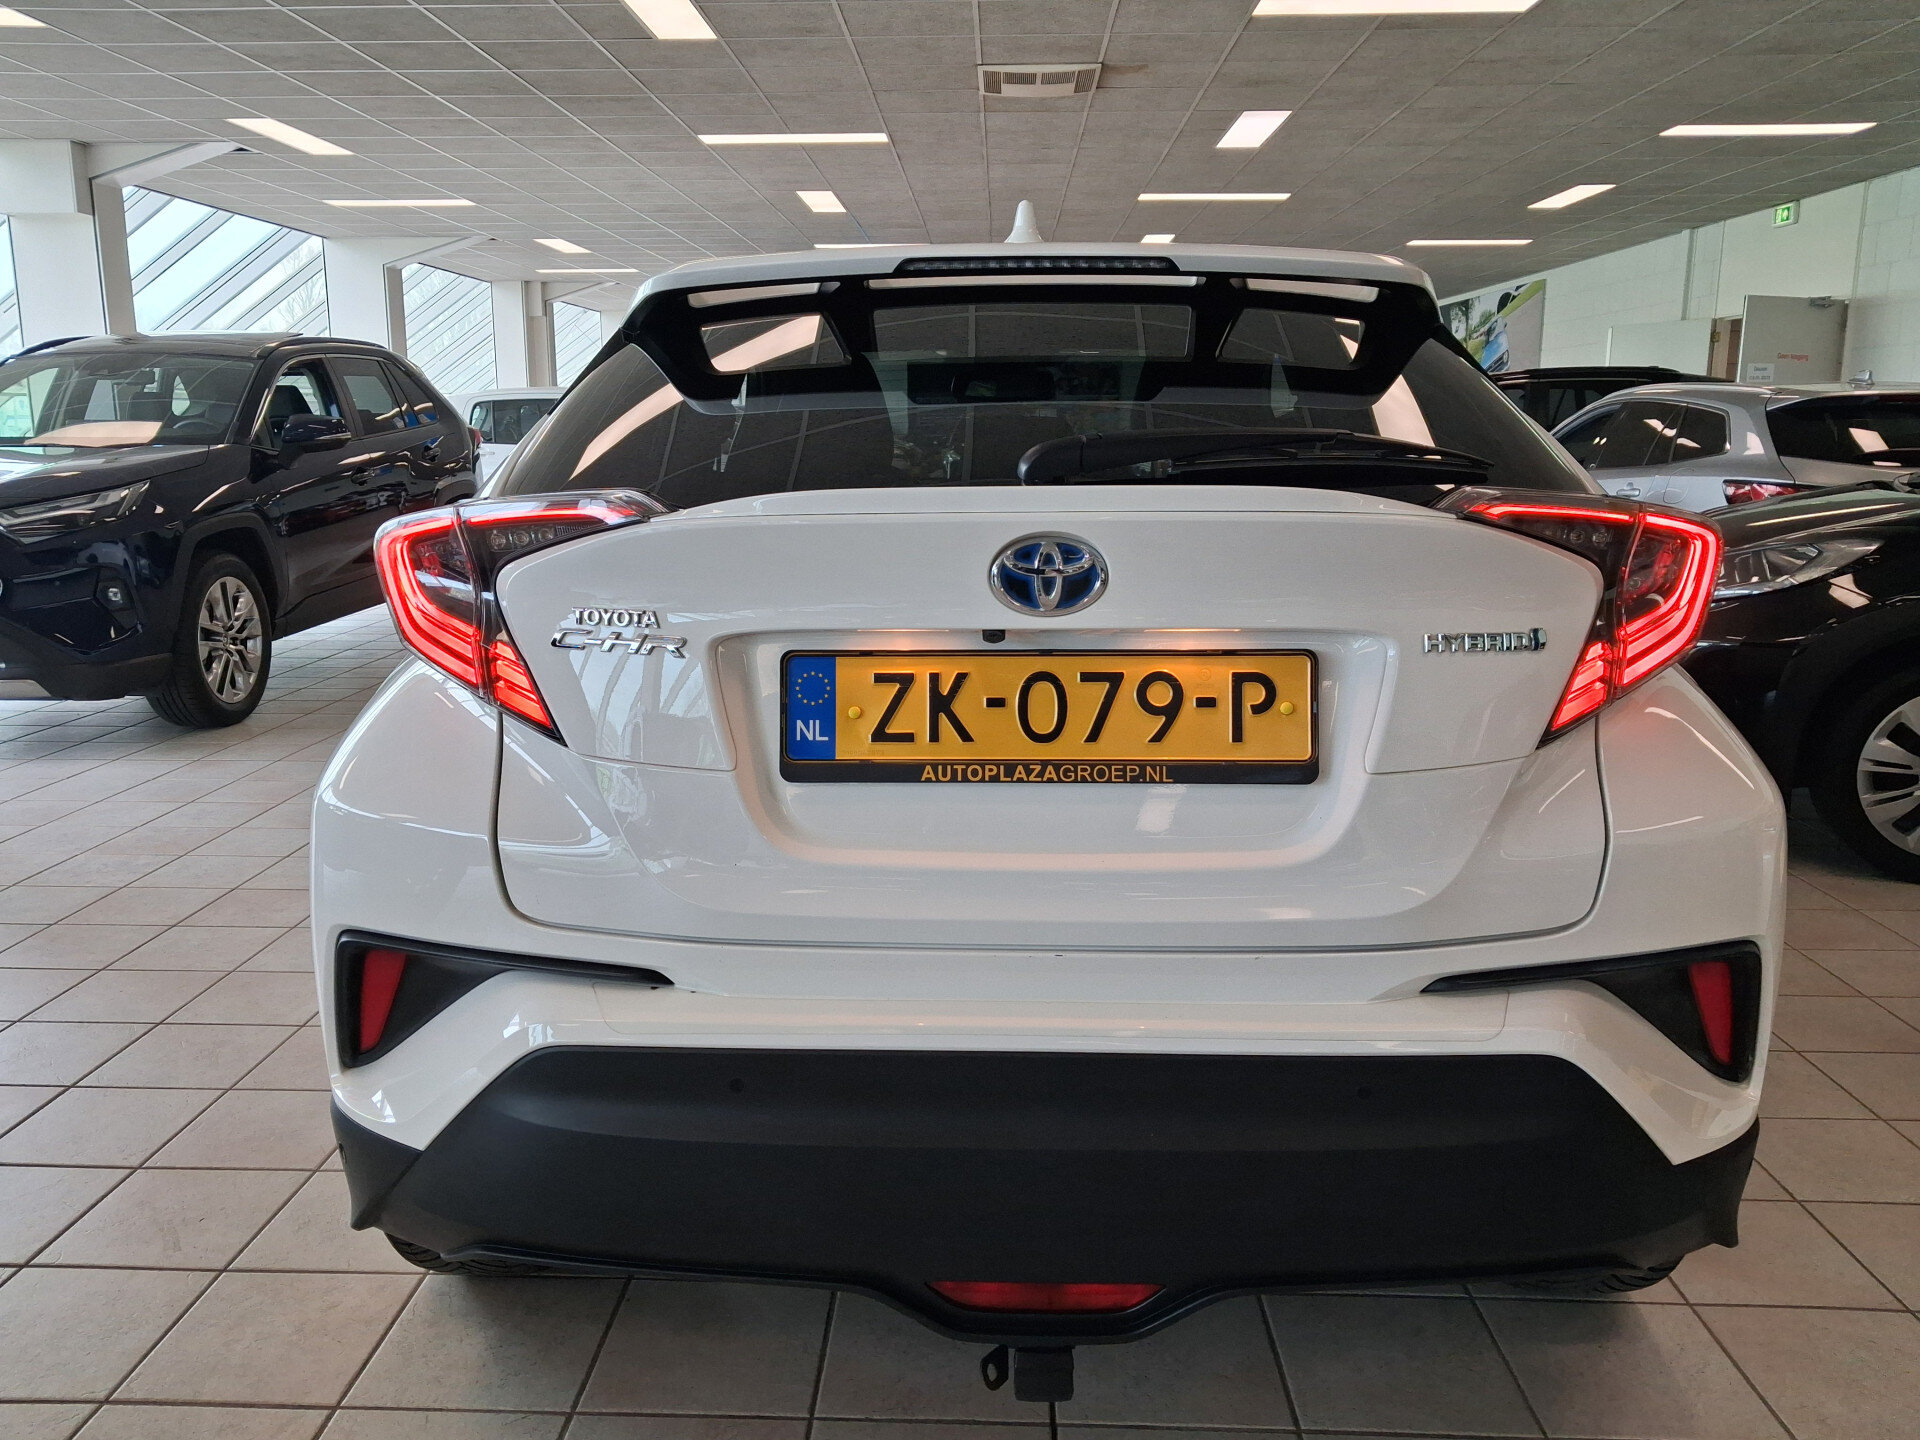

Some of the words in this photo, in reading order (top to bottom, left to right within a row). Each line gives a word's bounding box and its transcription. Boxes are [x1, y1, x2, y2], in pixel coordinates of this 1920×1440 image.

[572, 607, 661, 629] TOYOTA
[551, 628, 687, 658] C-HR
[1424, 632, 1530, 652] HYBRID
[870, 671, 1277, 744] ZK-079-P
[796, 719, 829, 741] NL
[921, 764, 1174, 783] AUTOPLAZAGROEP.NL
